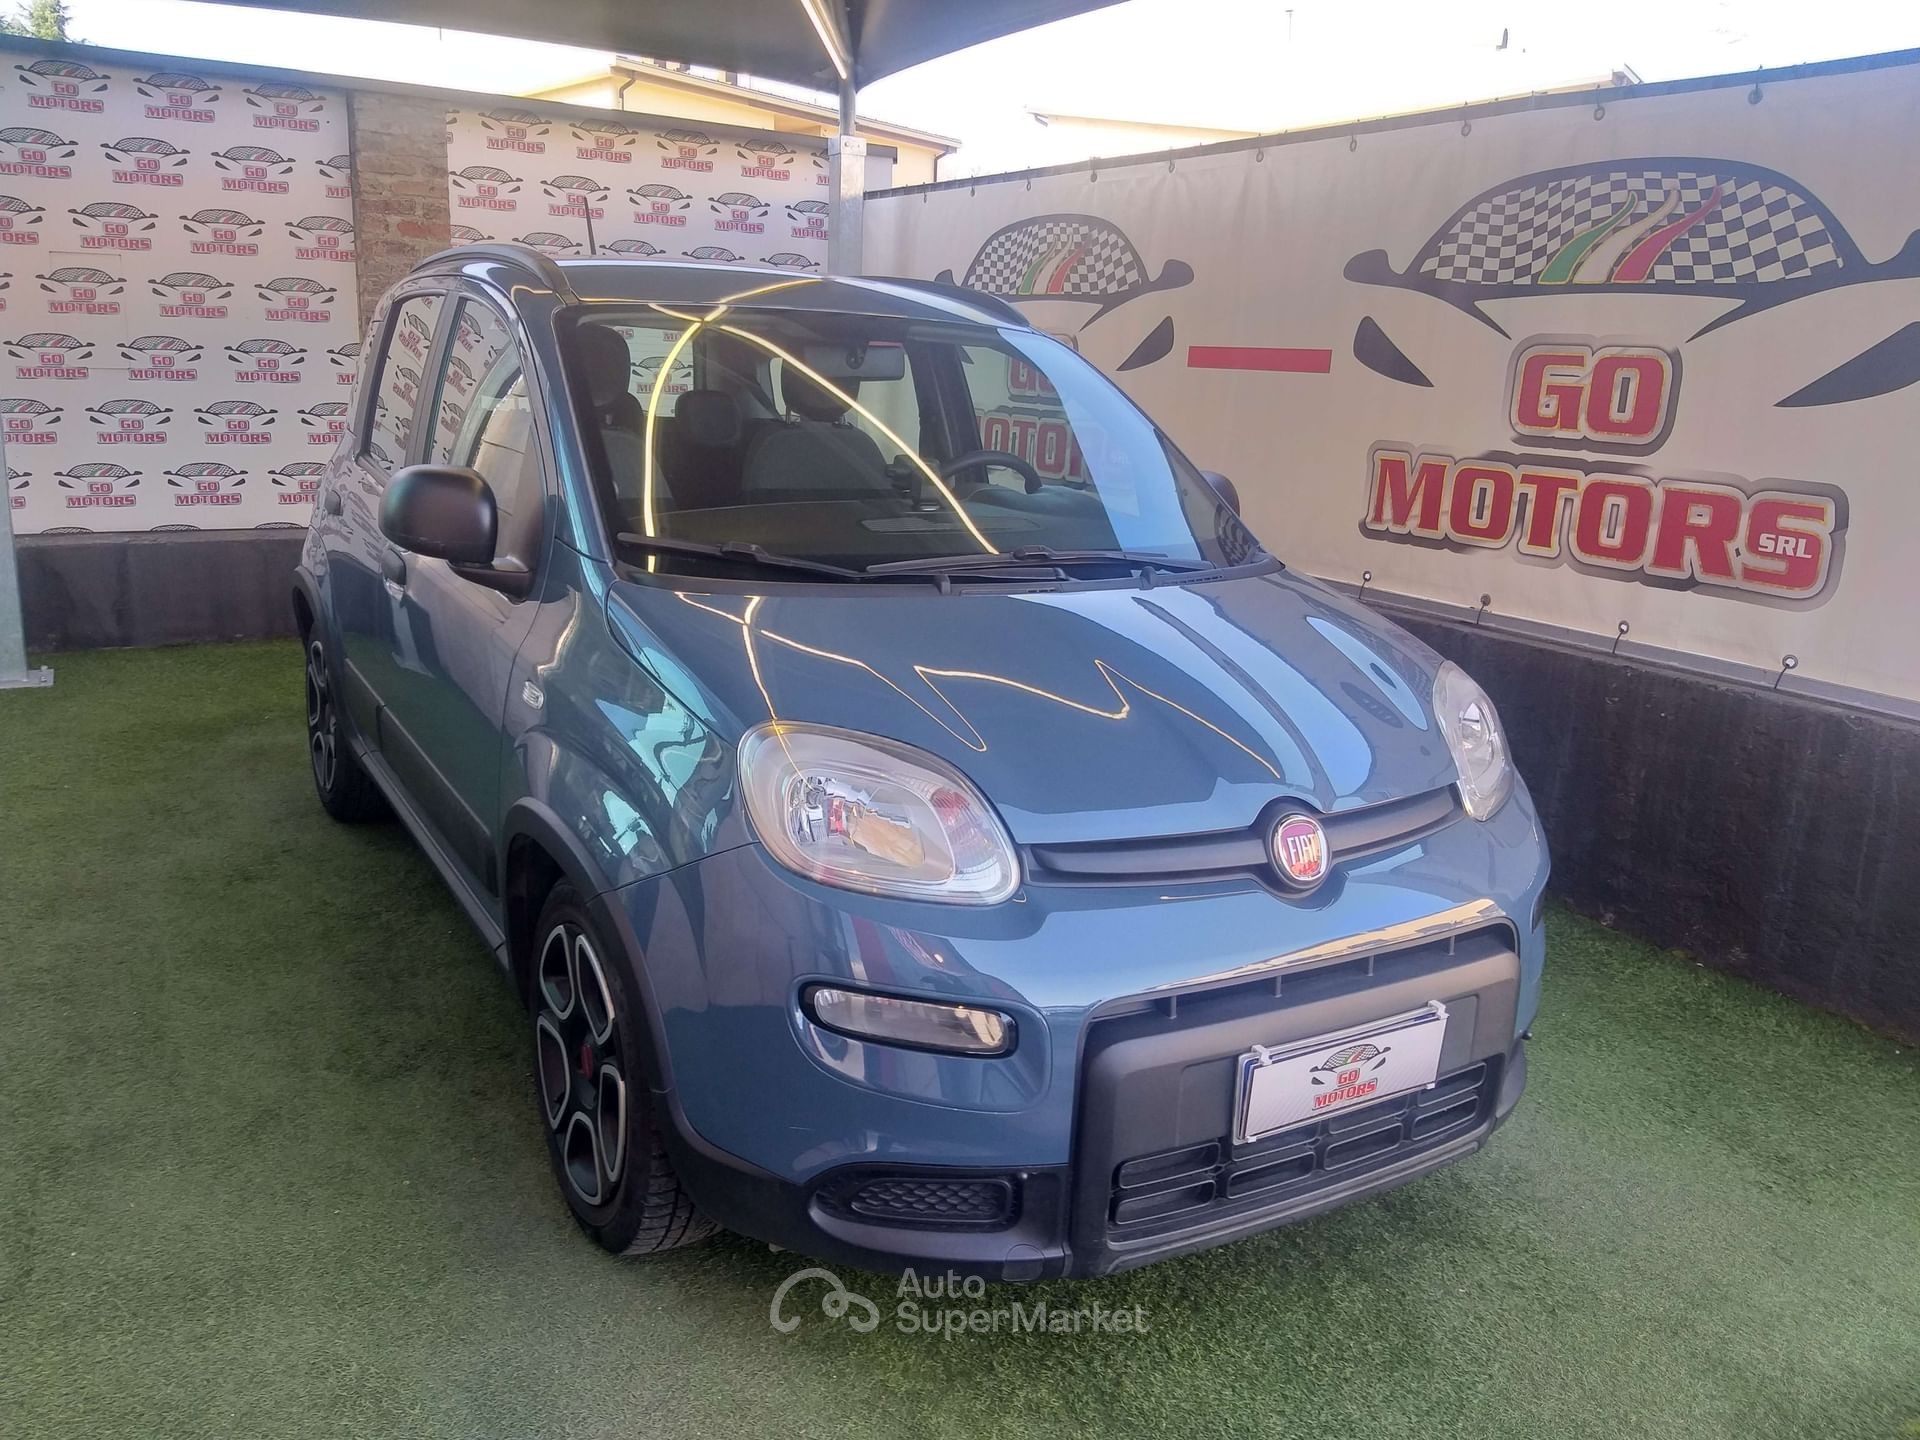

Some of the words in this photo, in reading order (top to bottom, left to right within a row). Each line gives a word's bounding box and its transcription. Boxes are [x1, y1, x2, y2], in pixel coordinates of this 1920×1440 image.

[53, 82, 78, 95] GO
[29, 94, 103, 112] MOTORS
[168, 94, 191, 106] GO
[146, 106, 214, 122] MOTORS
[275, 104, 297, 115] GO
[255, 116, 319, 131] MOTORS
[506, 127, 525, 139] GO
[488, 139, 545, 153] MOTORS
[596, 137, 613, 149] GO
[20, 149, 45, 162] GO
[578, 148, 631, 162] MOTORS
[679, 147, 696, 158] GO
[136, 158, 159, 170] GO
[662, 157, 713, 172] MOTORS
[758, 156, 774, 167] GO
[114, 171, 183, 185] MOTORS
[244, 166, 266, 178] GO
[742, 166, 790, 180] MOTORS
[223, 179, 288, 193] MOTORS
[479, 185, 496, 196] GO
[460, 197, 516, 210] MOTORS
[568, 193, 584, 204] GO
[652, 202, 669, 212] GO
[636, 213, 686, 226] MOTORS
[733, 210, 748, 220] GO
[0, 218, 12, 228] O
[716, 221, 764, 234] MOTORS
[808, 216, 823, 228] GO
[104, 222, 127, 235] GO
[0, 233, 38, 244] ORS
[212, 229, 235, 241] GO
[317, 235, 338, 247] GO
[82, 236, 151, 250] MOTORS
[192, 242, 258, 255] MOTORS
[73, 288, 95, 300] GO
[182, 292, 204, 303] GO
[50, 302, 119, 314] MOTORS
[288, 296, 308, 308] GO
[161, 306, 227, 318] MOTORS
[267, 309, 329, 321] MOTORS
[40, 354, 64, 365] GO
[152, 356, 174, 366] GO
[258, 358, 278, 368] GO
[18, 367, 88, 378] MOTORS
[130, 368, 197, 380] MOTORS
[236, 371, 300, 382] MOTORS
[1511, 344, 1674, 446] GO
[10, 419, 31, 430] GO
[121, 419, 143, 430] GO
[228, 420, 248, 430] GO
[4, 432, 56, 443] OTORS
[99, 432, 166, 443] MOTORS
[206, 432, 270, 443] MOTORS
[309, 434, 339, 443] MOT
[89, 482, 112, 493] GO
[198, 481, 218, 492] GO
[68, 495, 136, 506] MOTORS
[176, 494, 241, 504] MOTORS
[1363, 448, 1837, 599] MOTORS
[1757, 532, 1813, 560] SRL
[1287, 833, 1317, 864] FIAT
[1338, 1068, 1359, 1086] GO
[1313, 1078, 1377, 1109] MOTORS
